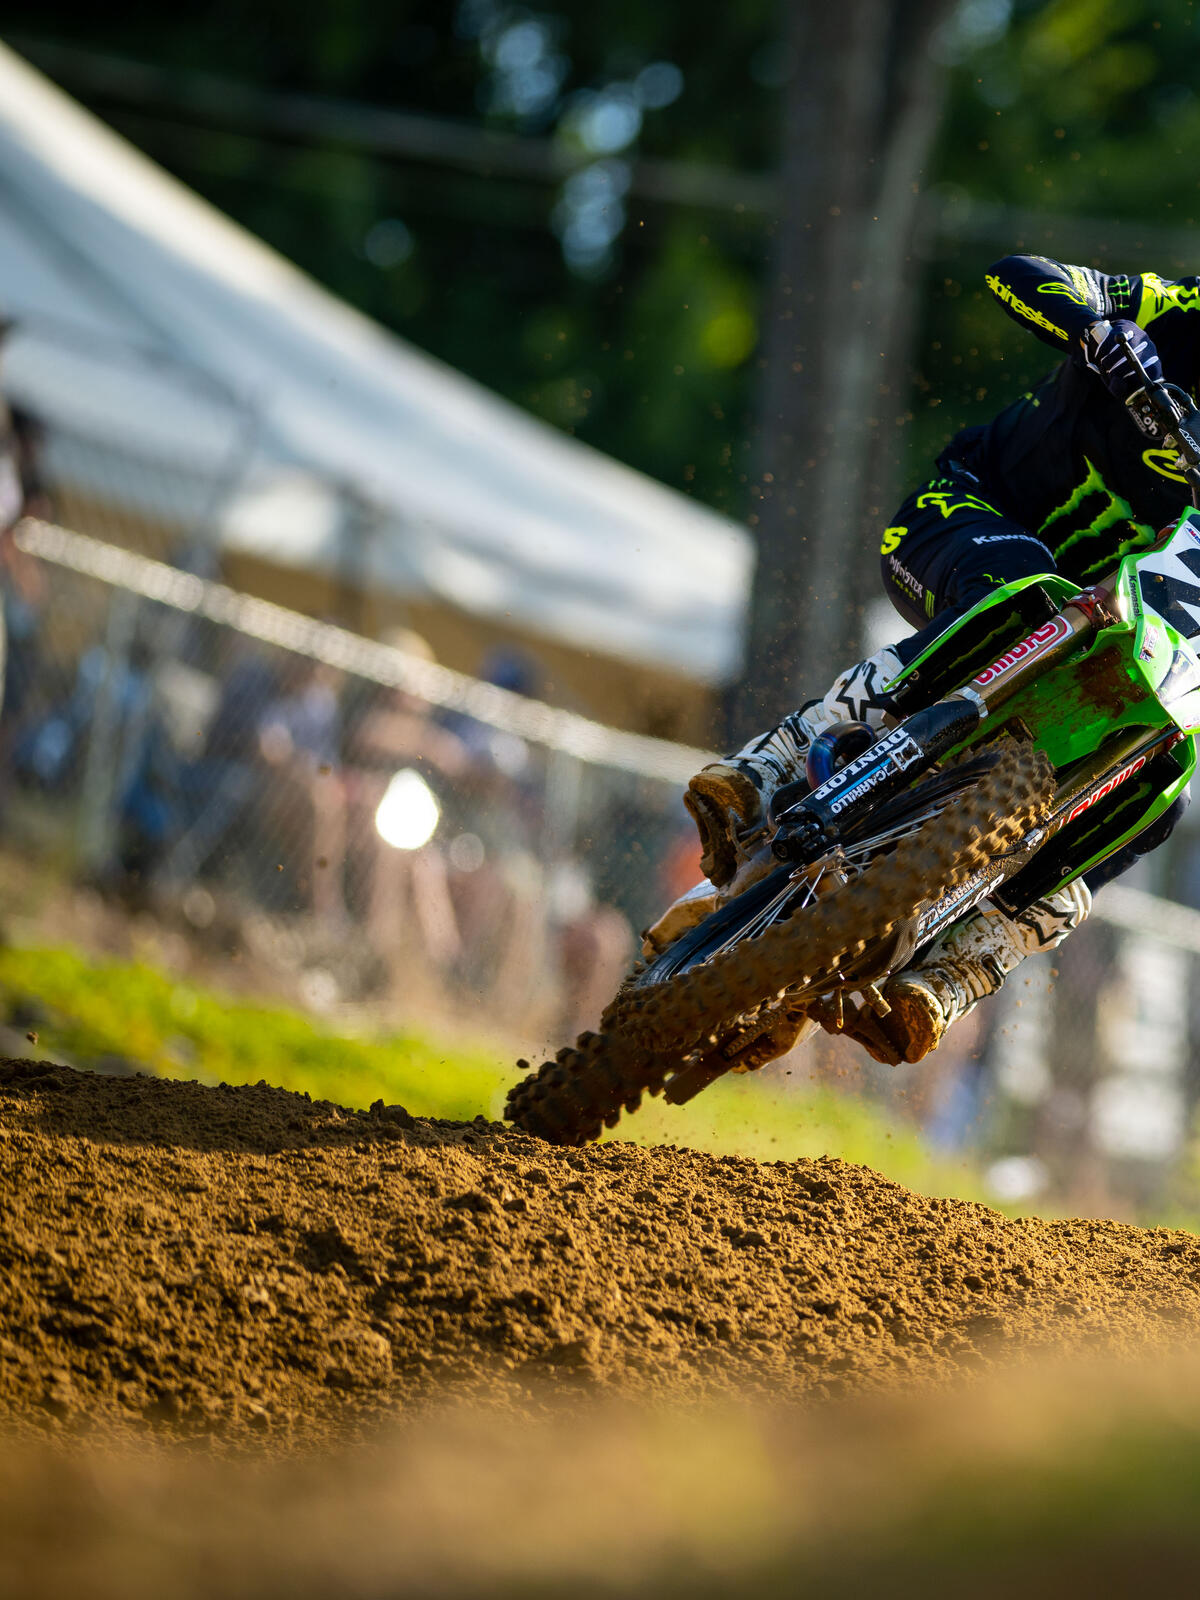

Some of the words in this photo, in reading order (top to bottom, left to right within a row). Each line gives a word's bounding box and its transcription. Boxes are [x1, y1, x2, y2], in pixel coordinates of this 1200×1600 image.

[984, 274, 1070, 341] alpinestars
[814, 727, 909, 800] DUNLOP
[831, 769, 887, 814] CARRILLO
